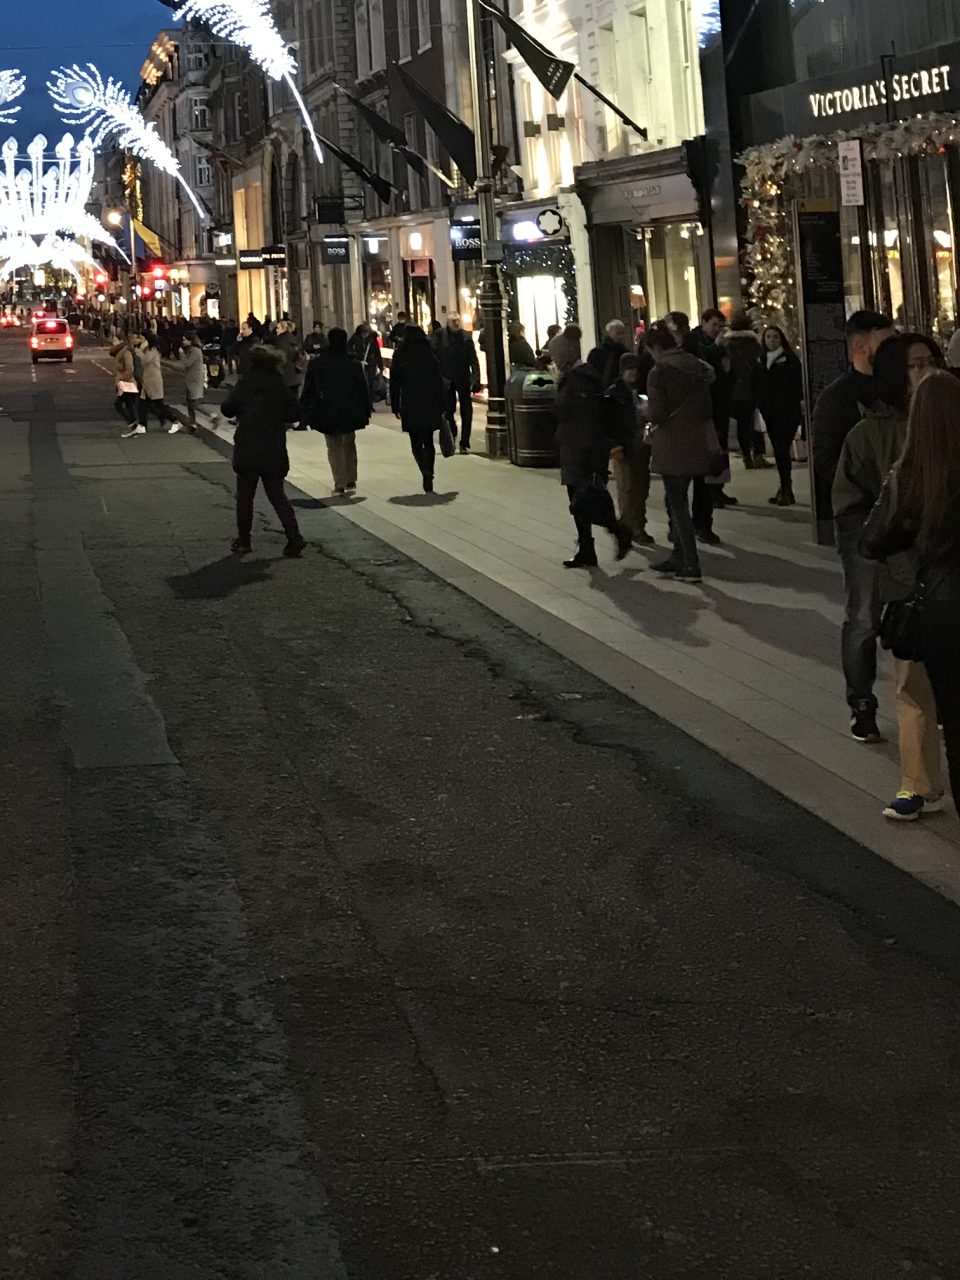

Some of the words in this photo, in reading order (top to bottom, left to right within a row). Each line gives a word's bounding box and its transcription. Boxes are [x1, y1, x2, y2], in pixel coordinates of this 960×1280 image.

[809, 79, 887, 118] VICTORIA'S
[892, 65, 951, 102] SECRET
[455, 238, 481, 247] BOSS
